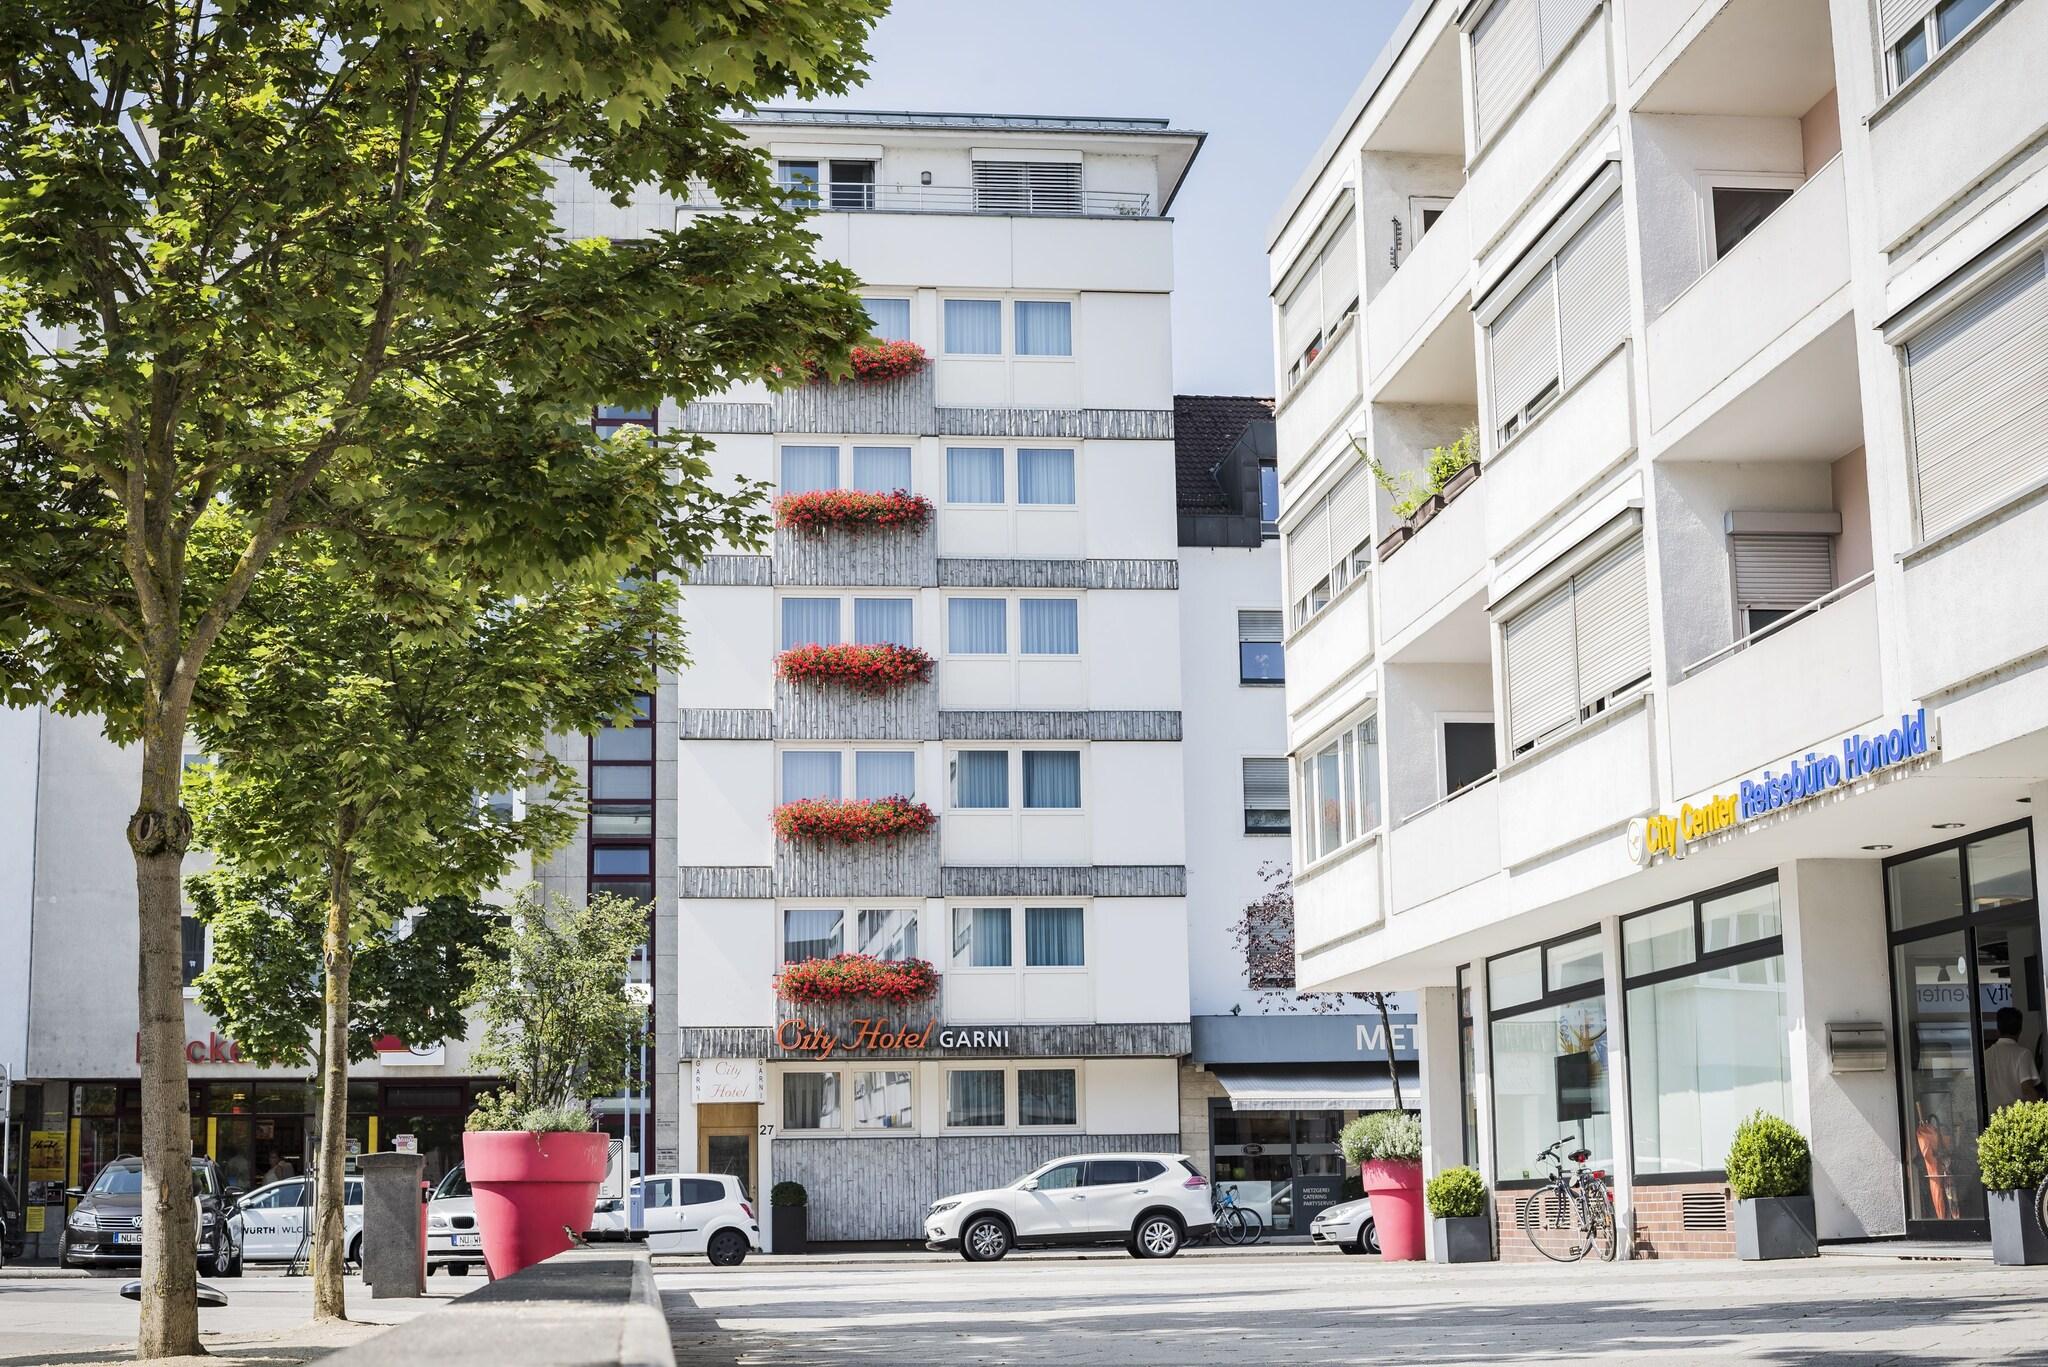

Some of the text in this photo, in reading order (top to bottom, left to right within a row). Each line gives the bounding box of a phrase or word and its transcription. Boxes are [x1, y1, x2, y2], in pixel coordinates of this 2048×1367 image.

[1646, 708, 1928, 856] City Center Reisebüro Honold
[776, 1017, 1009, 1061] City Hotel GARNI
[715, 1061, 742, 1079] City
[710, 1083, 750, 1098] Hotel
[759, 1125, 774, 1136] 27
[121, 1234, 131, 1242] NU
[459, 1235, 470, 1244] NU
